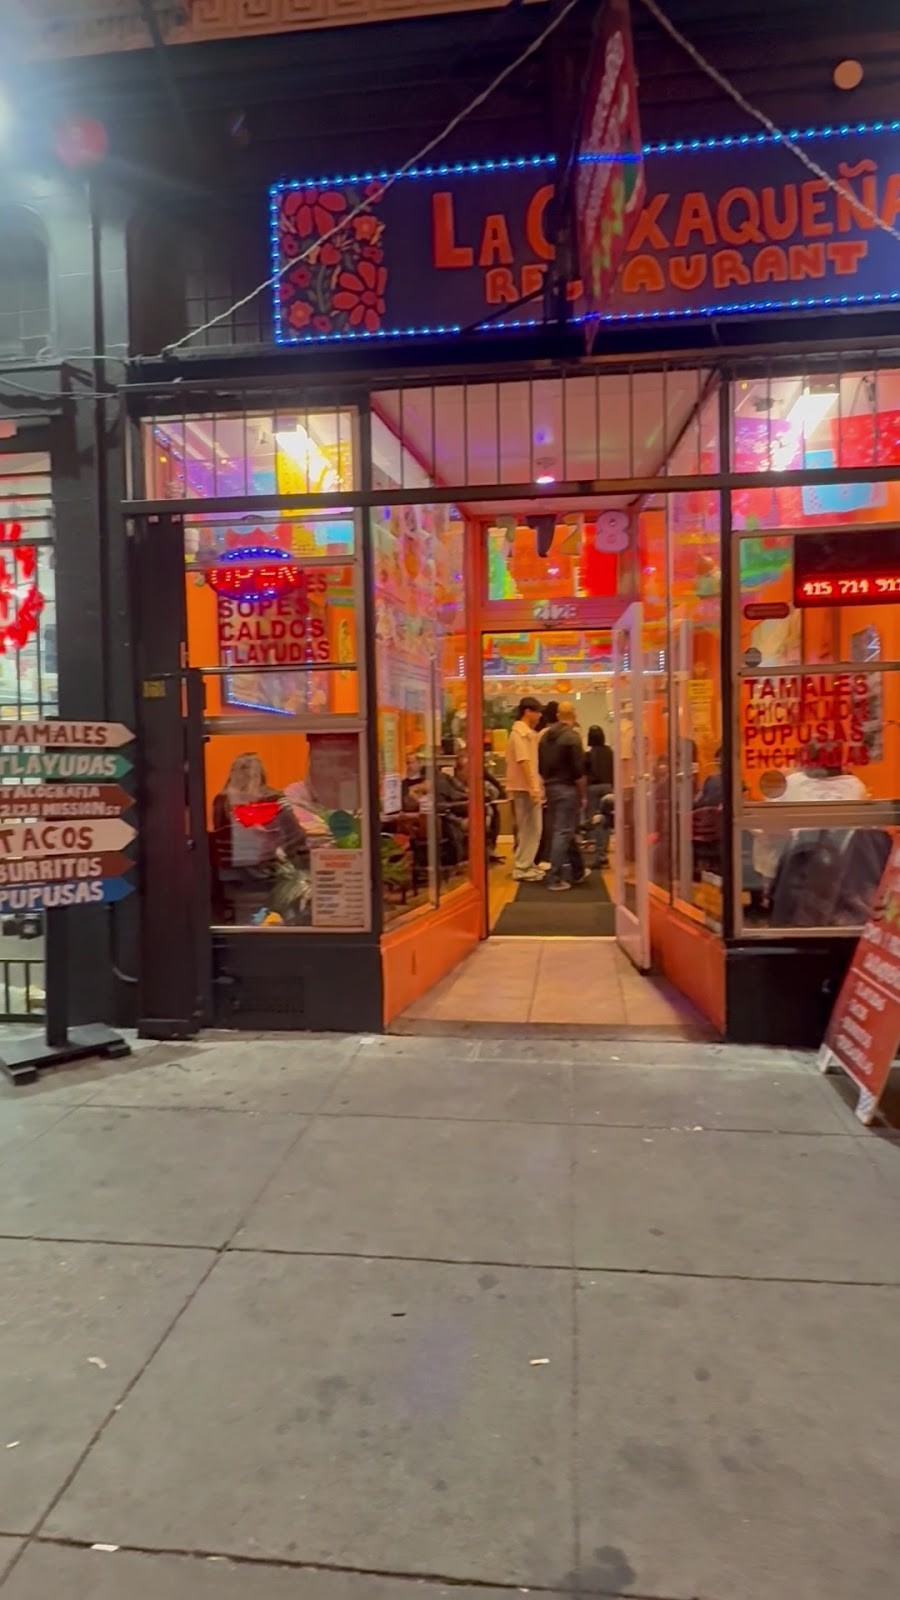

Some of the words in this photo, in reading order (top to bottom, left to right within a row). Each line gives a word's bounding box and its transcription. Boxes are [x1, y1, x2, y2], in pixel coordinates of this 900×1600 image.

[432, 191, 514, 268] LA
[527, 159, 900, 261] OXAQUEÑ
[486, 240, 867, 304] REAURANT
[211, 565, 299, 588] OPEN
[803, 581, 832, 596] 415
[218, 598, 310, 619] SOPES
[219, 618, 324, 642] CALDOS
[220, 640, 330, 665] TLAYUDAS
[744, 673, 868, 700] TAMALES
[0, 724, 108, 745] TAMALES
[744, 722, 864, 747] PUPUSAS
[0, 755, 117, 777] TLAYUDAS
[0, 826, 94, 853] TACOS
[0, 857, 102, 883] BURRITOS
[0, 881, 104, 911] PUPUSAS
